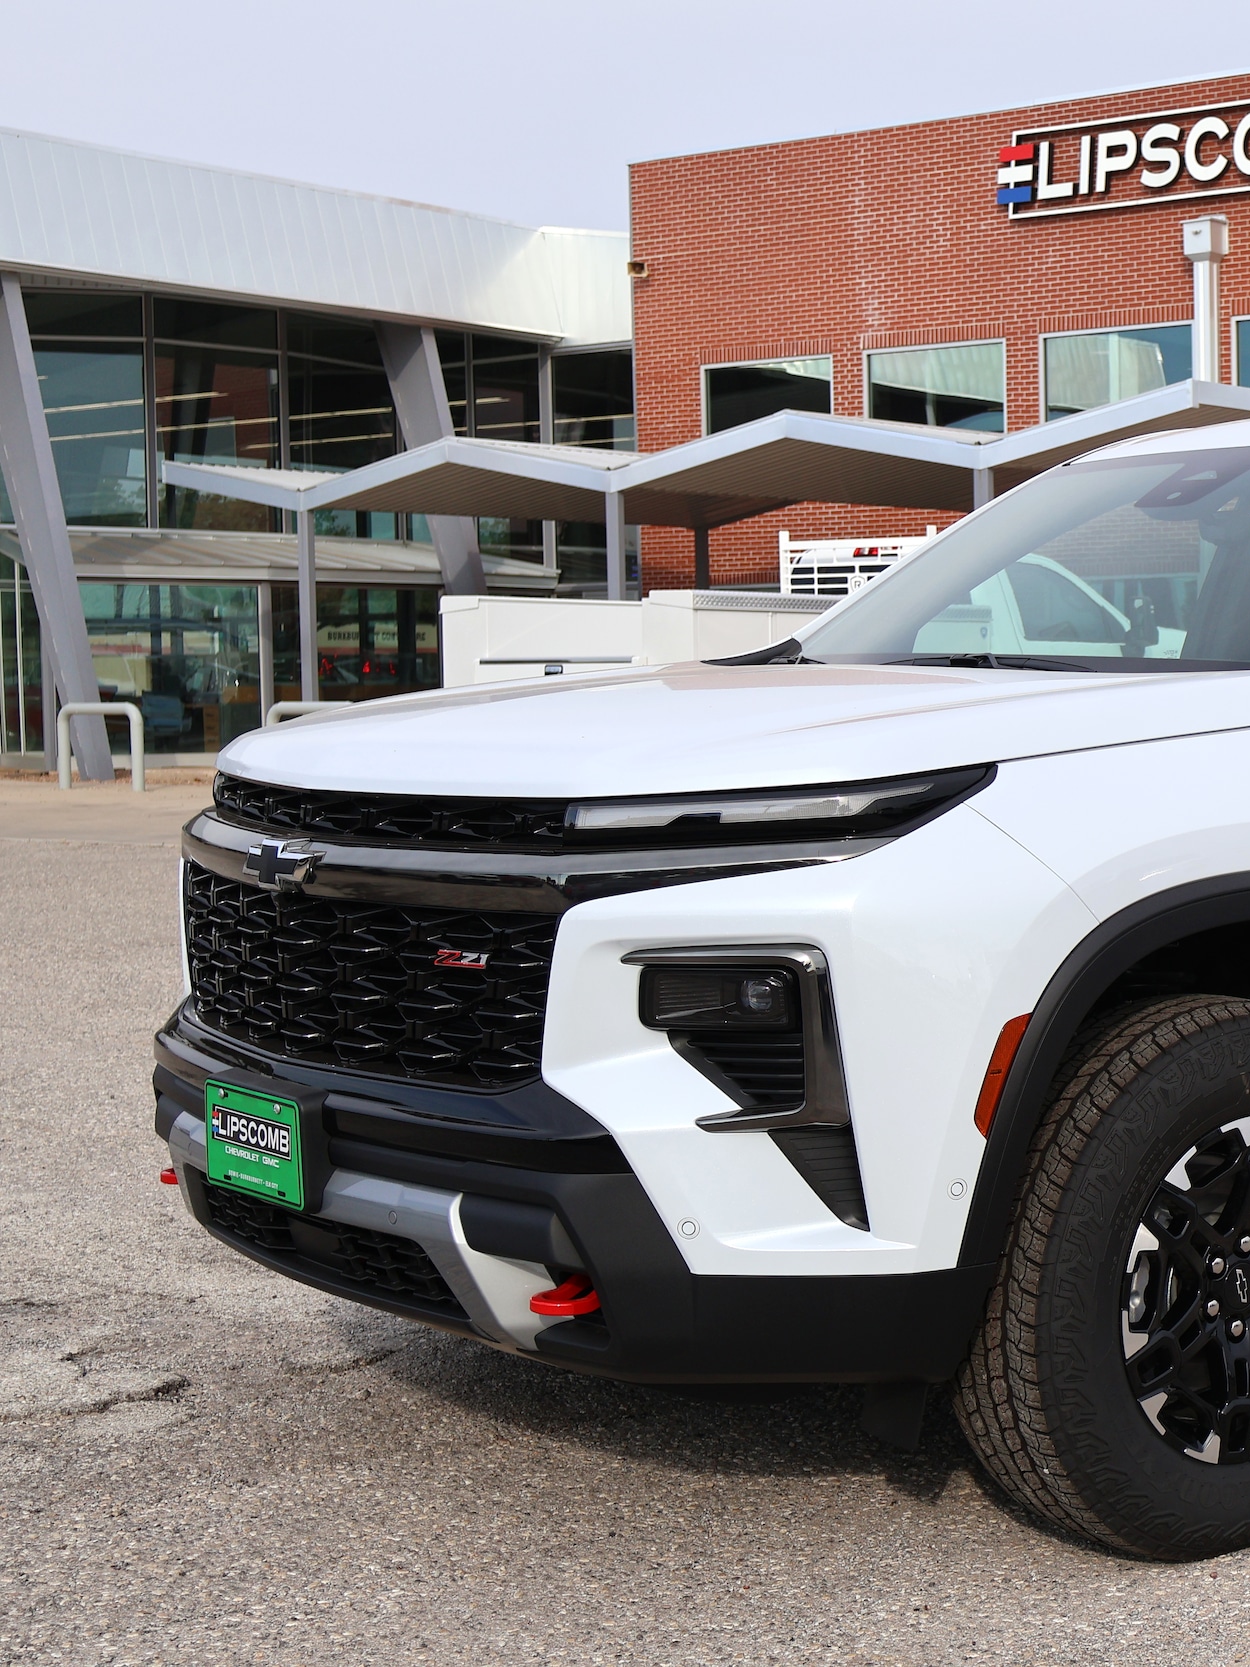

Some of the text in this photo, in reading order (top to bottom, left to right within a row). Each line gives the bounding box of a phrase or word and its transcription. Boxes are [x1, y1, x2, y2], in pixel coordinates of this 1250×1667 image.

[434, 949, 490, 969] Z71
[218, 1113, 289, 1153] LIPSCOMB
[225, 1145, 279, 1168] CHEVROLET GMC
